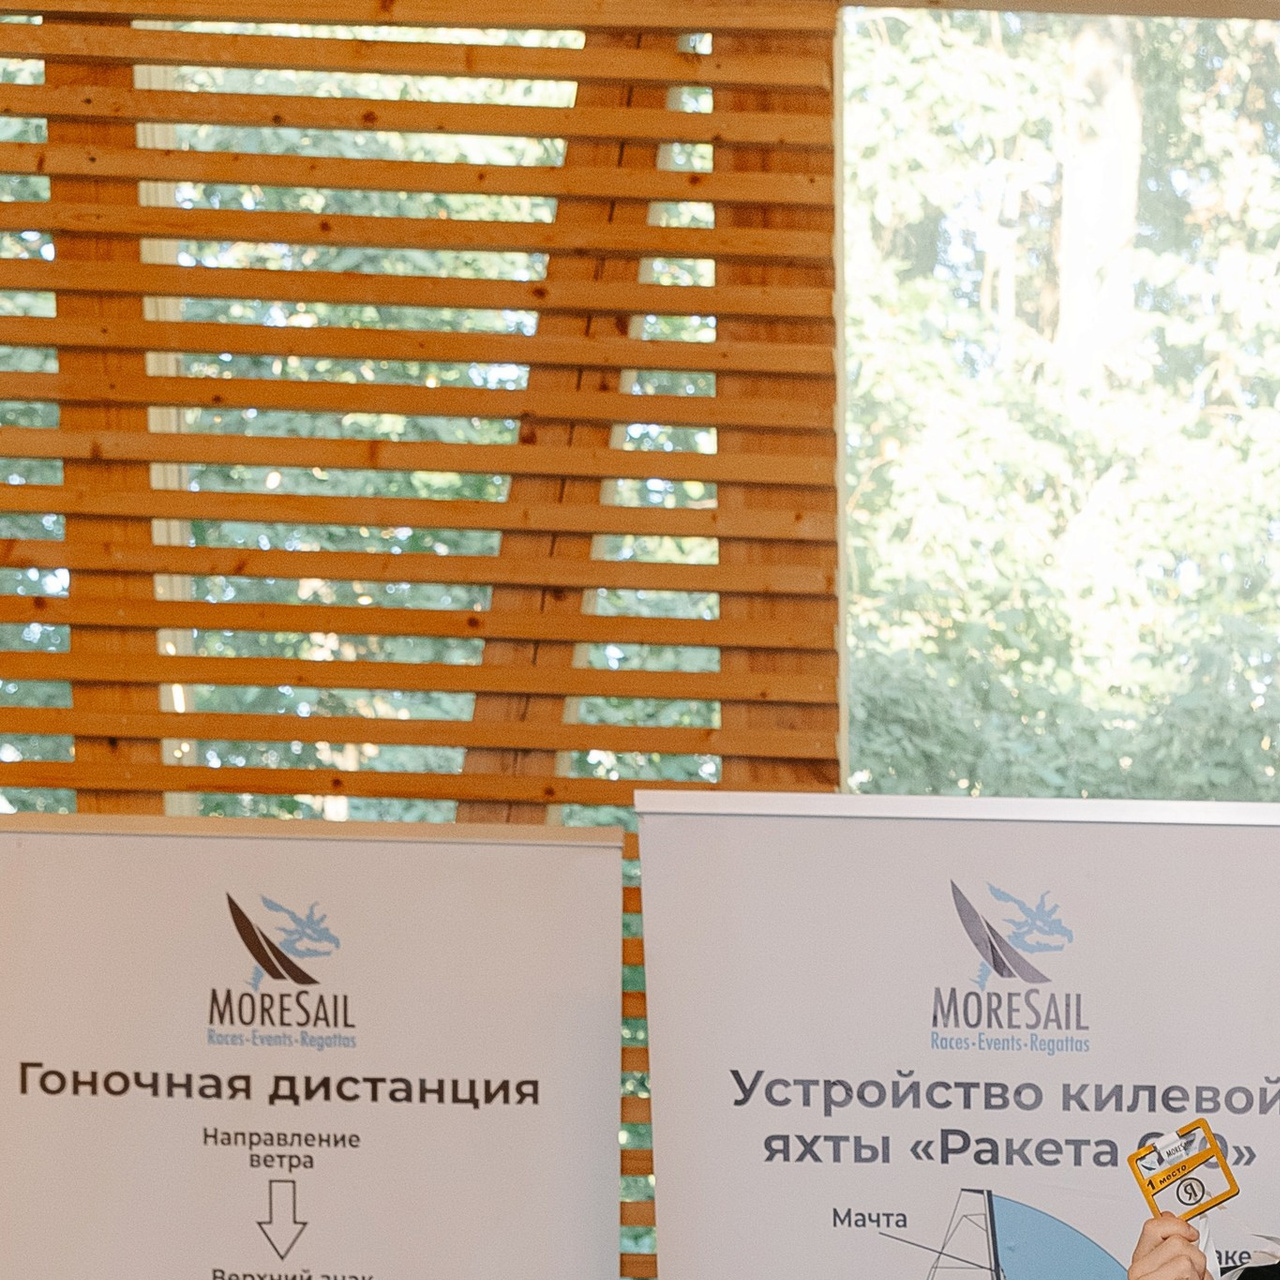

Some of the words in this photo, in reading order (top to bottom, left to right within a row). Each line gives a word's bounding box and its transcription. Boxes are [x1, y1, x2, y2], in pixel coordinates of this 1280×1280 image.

[19, 1062, 253, 1100] Гоночная
[268, 1073, 541, 1109] дистанция
[729, 1069, 1042, 1117] Устройство
[202, 1127, 361, 1150] Направление
[763, 1133, 891, 1165] яхты
[909, 1129, 1119, 1168] «Ракета
[249, 1151, 315, 1173] ветра
[1147, 1179, 1156, 1190] 1
[1159, 1165, 1187, 1185] место
[832, 1207, 908, 1228] Мачта
